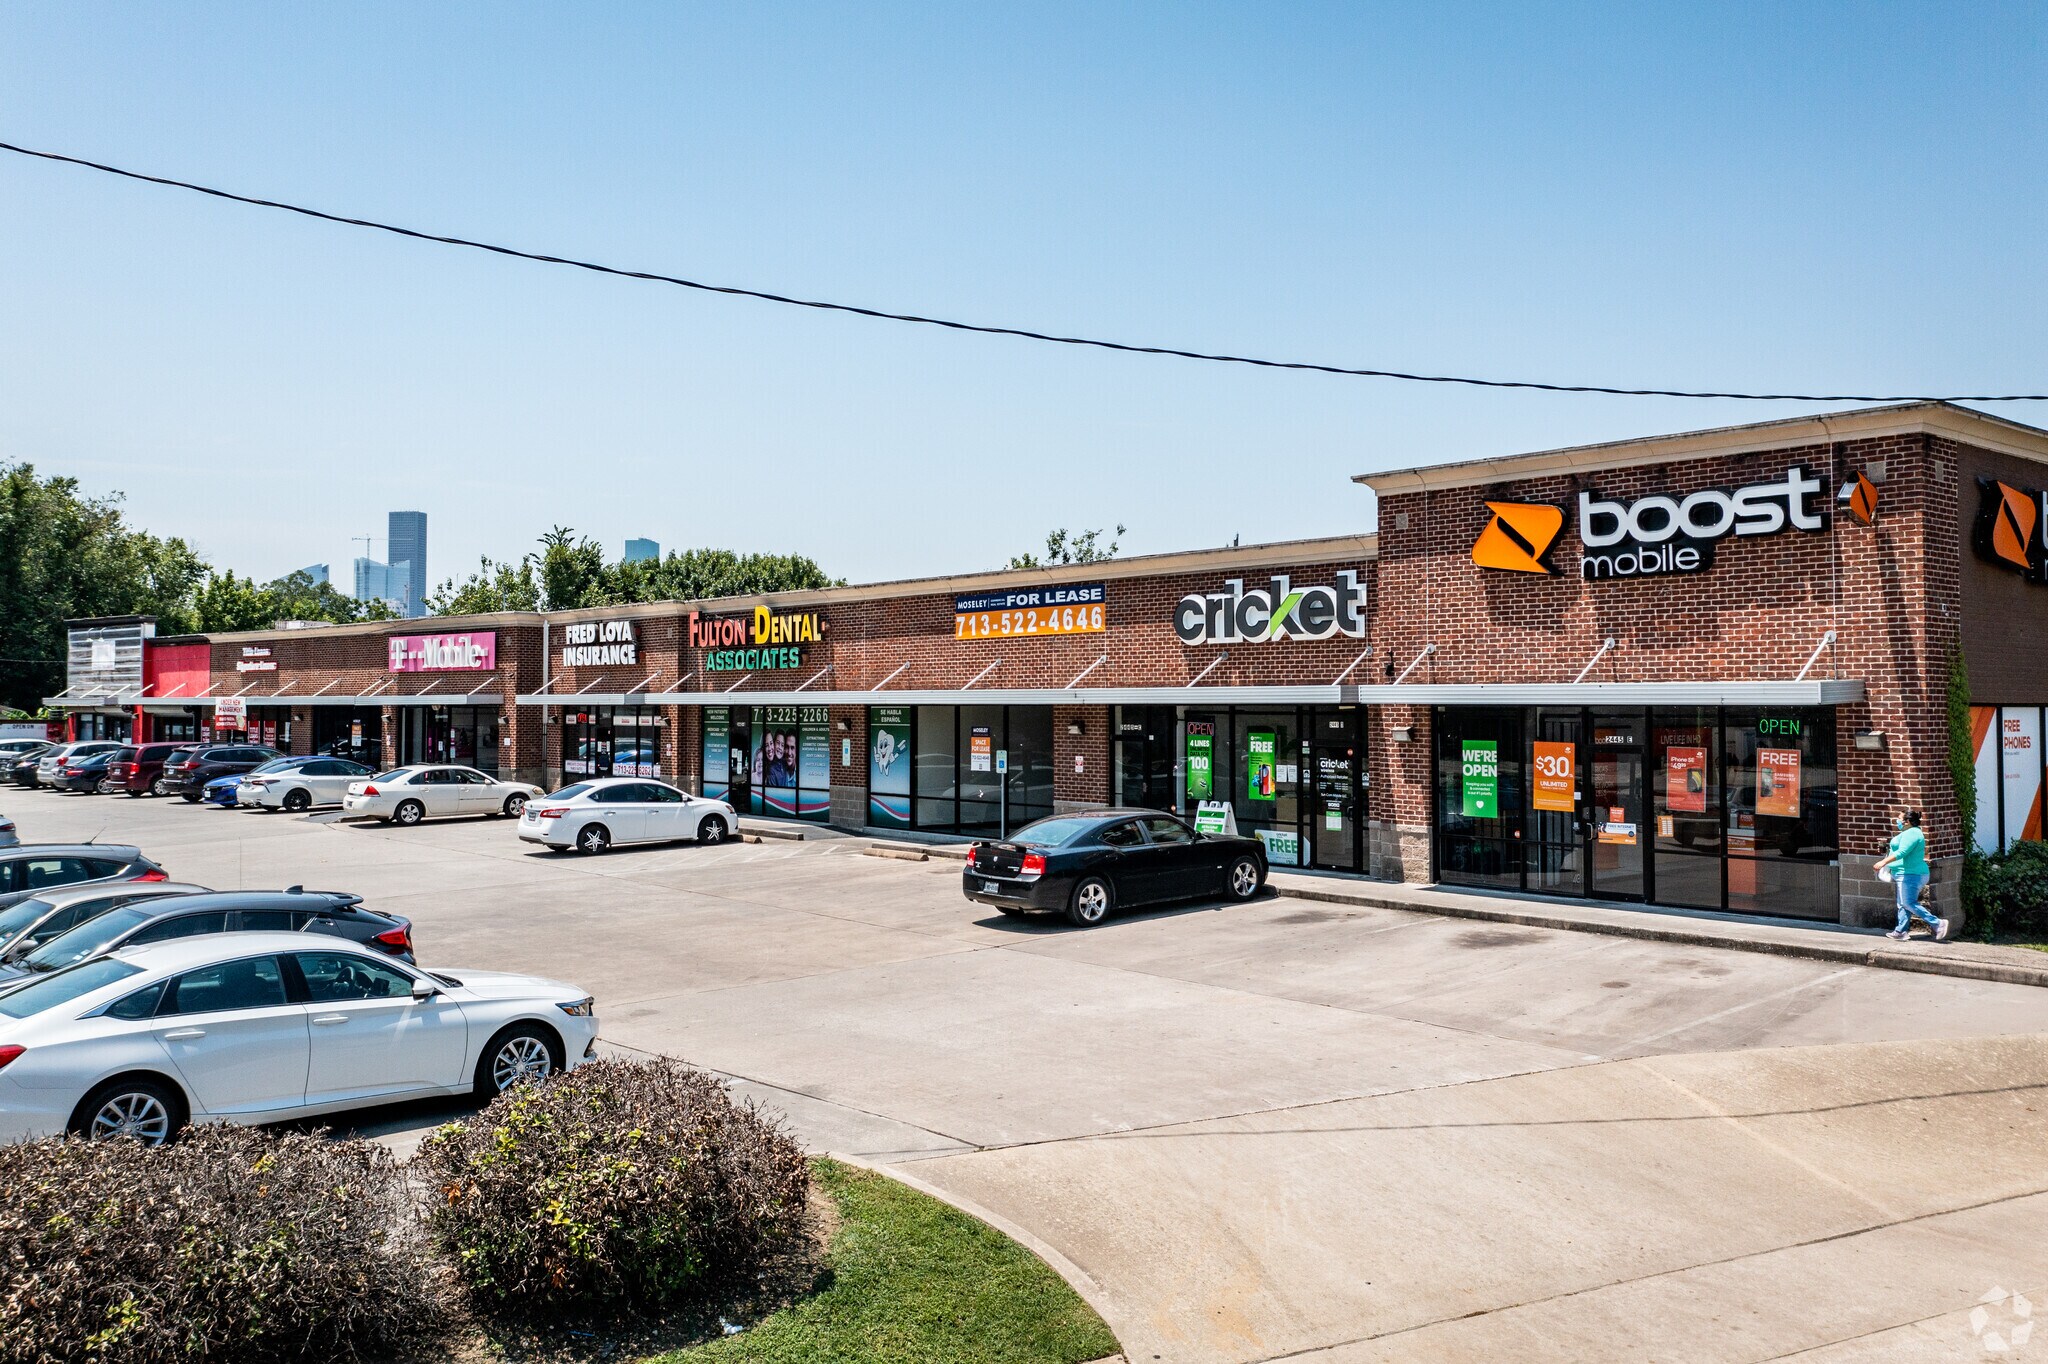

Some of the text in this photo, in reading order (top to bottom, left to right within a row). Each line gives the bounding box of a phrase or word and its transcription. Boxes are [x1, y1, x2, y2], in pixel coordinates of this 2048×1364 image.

[1579, 467, 1822, 547] boost
[1581, 544, 1700, 578] mobile
[957, 599, 988, 610] MOSELEY
[1006, 592, 1040, 607] FOR
[1045, 588, 1102, 604] LEASE
[1173, 571, 1364, 644] cricket
[956, 606, 1103, 637] 713-522-4646
[565, 620, 633, 645] FRED LOYA
[563, 644, 636, 667] INSURANCE
[706, 647, 800, 671] ASSOCIATES
[1188, 723, 1214, 735] OPEN
[1760, 718, 1800, 735] OPEN
[2003, 719, 2020, 732] FREE
[1250, 741, 1273, 753] FREE
[1606, 735, 1623, 743] 2445
[2003, 735, 2031, 749] PHONES
[1463, 749, 1497, 763] WE'RE
[1761, 752, 1798, 766] FREE
[1320, 759, 1349, 770] cricket
[1463, 764, 1497, 777] OPEN
[1536, 756, 1570, 778] $30
[1269, 838, 1298, 854] FREE
